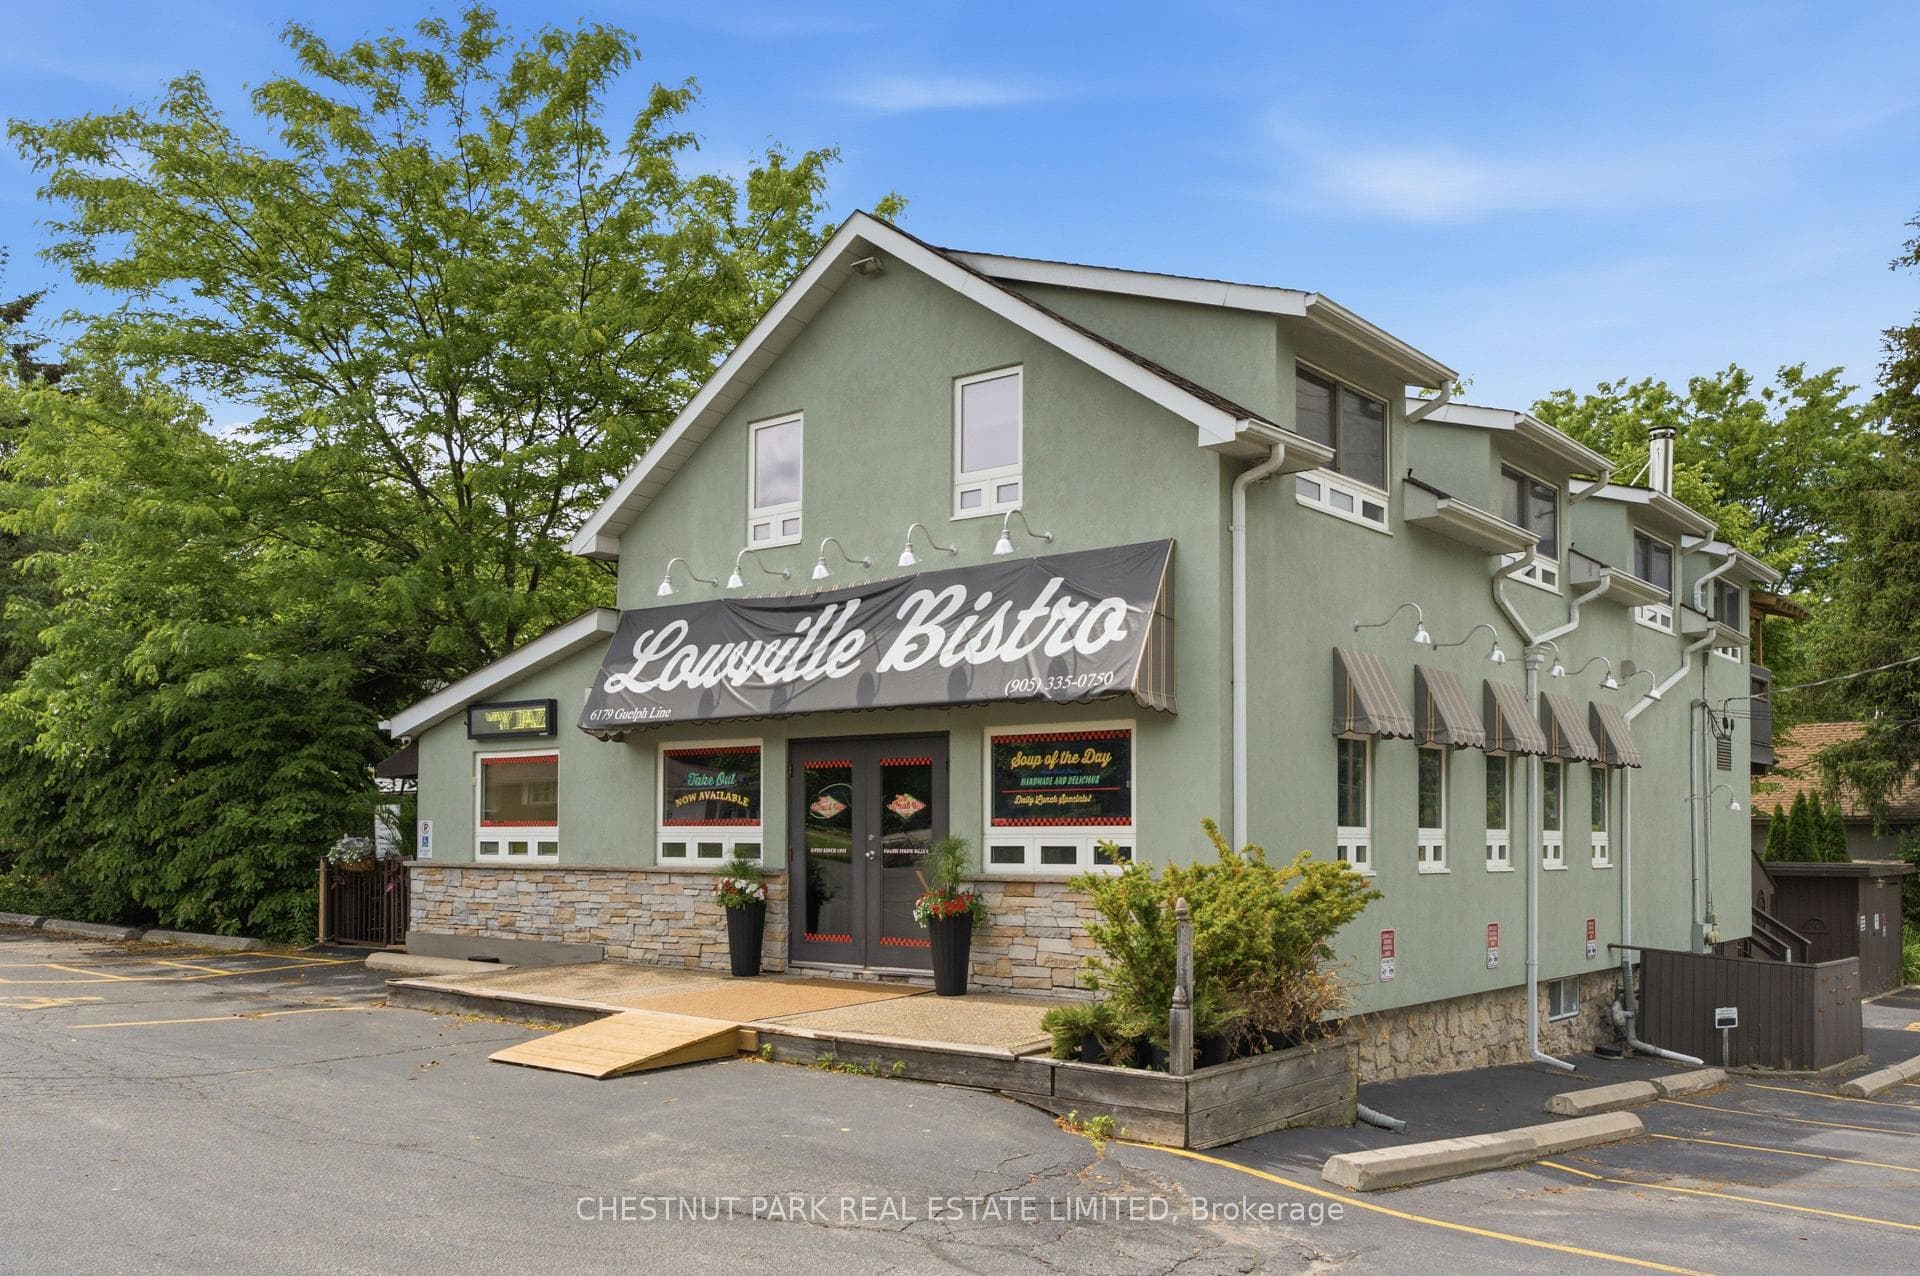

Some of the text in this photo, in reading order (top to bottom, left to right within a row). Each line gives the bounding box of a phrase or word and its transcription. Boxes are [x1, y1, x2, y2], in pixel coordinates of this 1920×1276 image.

[603, 577, 1128, 694] Lowville Bistro
[1004, 671, 1114, 696] (905) 335-0750
[590, 705, 672, 722] 6179 Guelph Line
[1010, 748, 1112, 769] Soup of the Day
[687, 771, 737, 787] Take Out
[675, 790, 751, 808] NOW AVAILABLE
